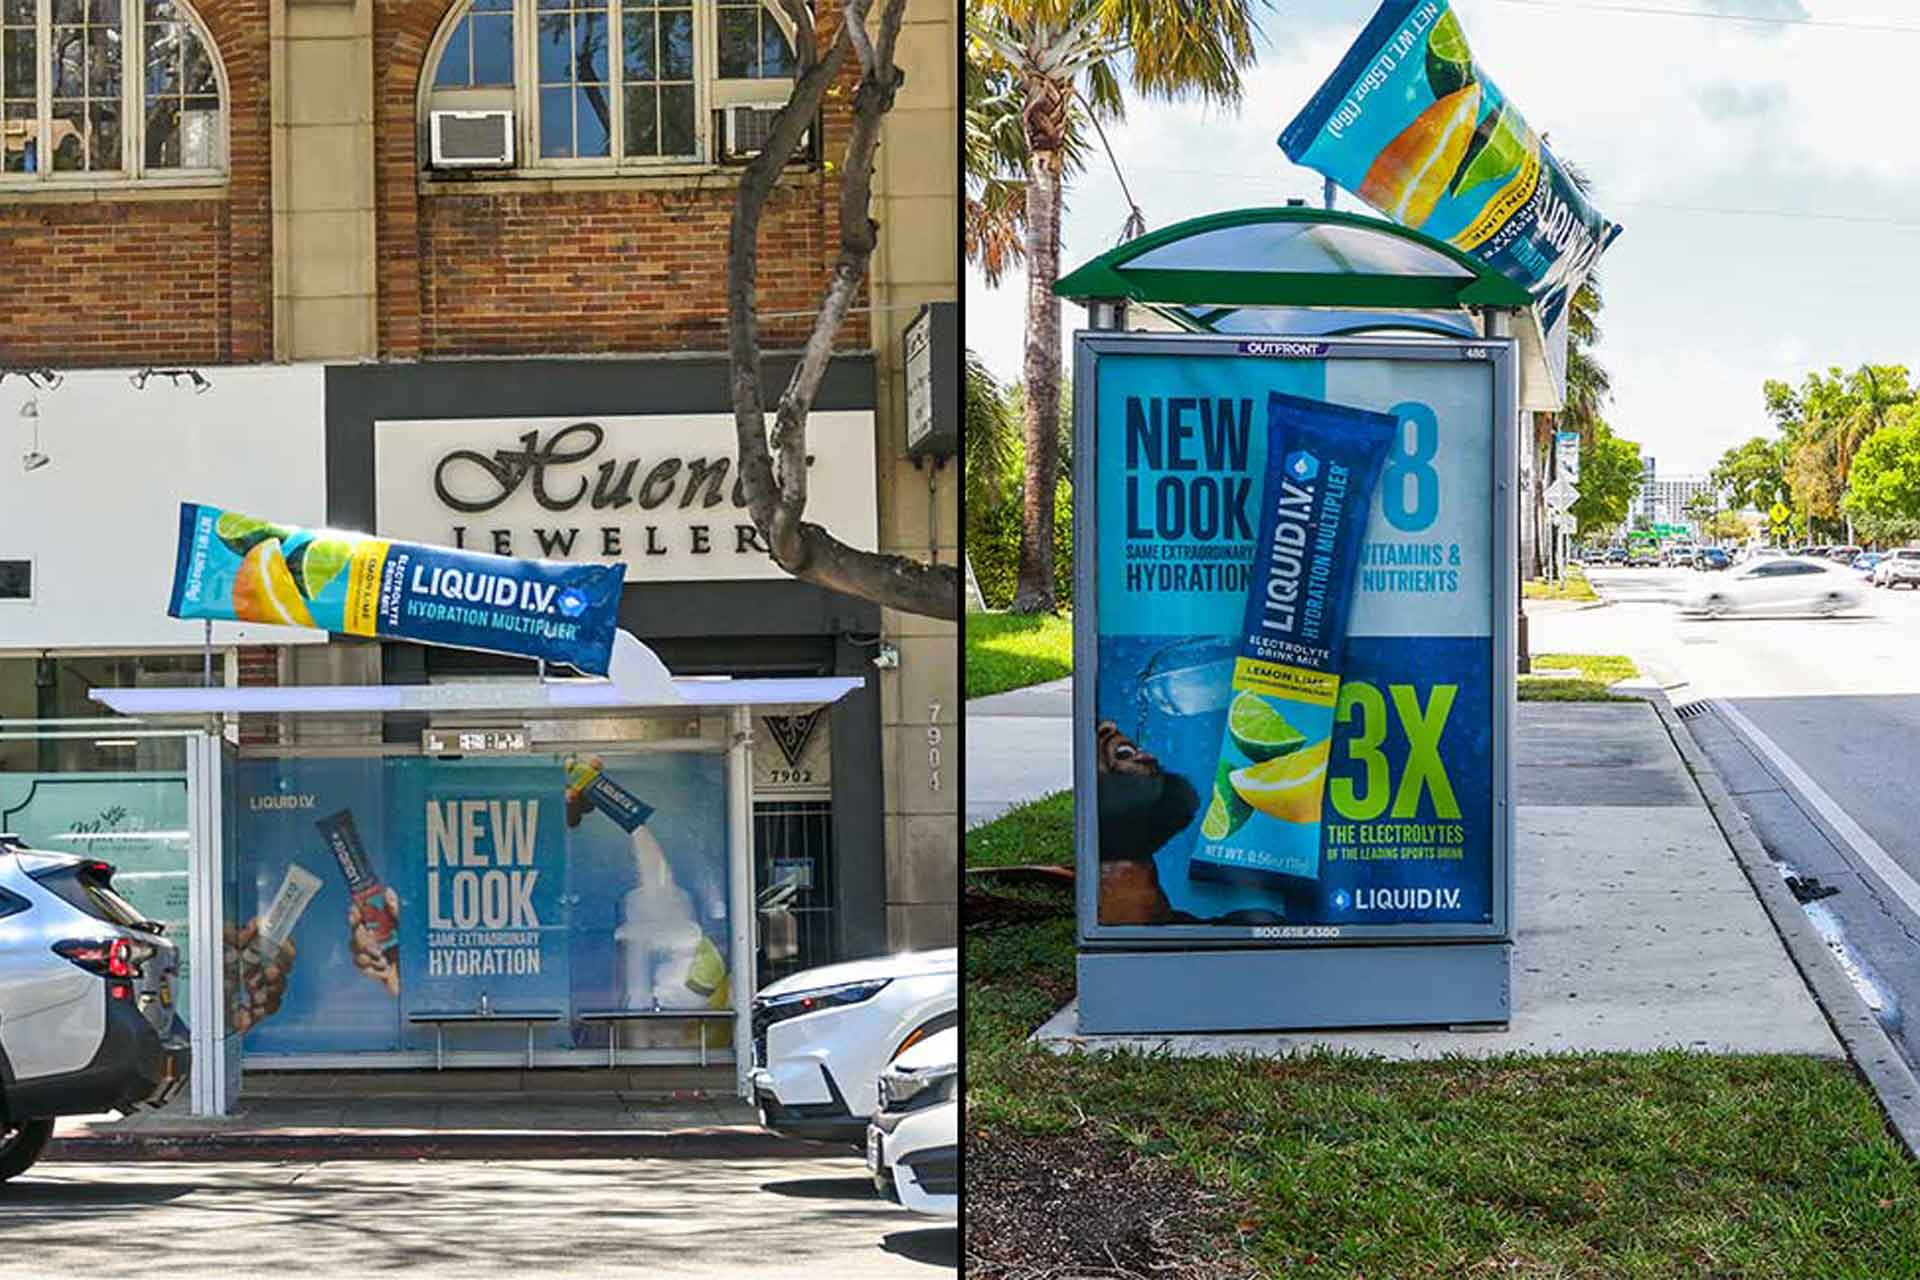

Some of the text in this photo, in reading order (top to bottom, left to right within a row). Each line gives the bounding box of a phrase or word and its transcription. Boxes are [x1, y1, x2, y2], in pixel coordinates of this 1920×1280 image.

[1410, 1, 1438, 35] NET
[1247, 342, 1320, 354] OUTFRONT
[1125, 396, 1254, 471] NEW
[1382, 401, 1440, 534] 8
[1125, 476, 1256, 541] LOOK
[1301, 463, 1350, 640] HYDRATION MULTIPLIER
[1449, 543, 1461, 567] &
[388, 553, 410, 626] ELECTROLYTE
[1126, 563, 1253, 592] HYDRATION
[1362, 570, 1458, 593] NUTRIENTS
[407, 599, 578, 641] HYDRATION MULTIPLIER
[1249, 634, 1330, 660] ELECTROLYTE
[1329, 681, 1463, 822] 3X
[769, 770, 812, 783] 7902
[426, 799, 540, 867] NEW
[1327, 824, 1465, 845] THE ELECTROLYTES
[428, 869, 540, 929] LOOK
[428, 949, 541, 977] HYDRATION
